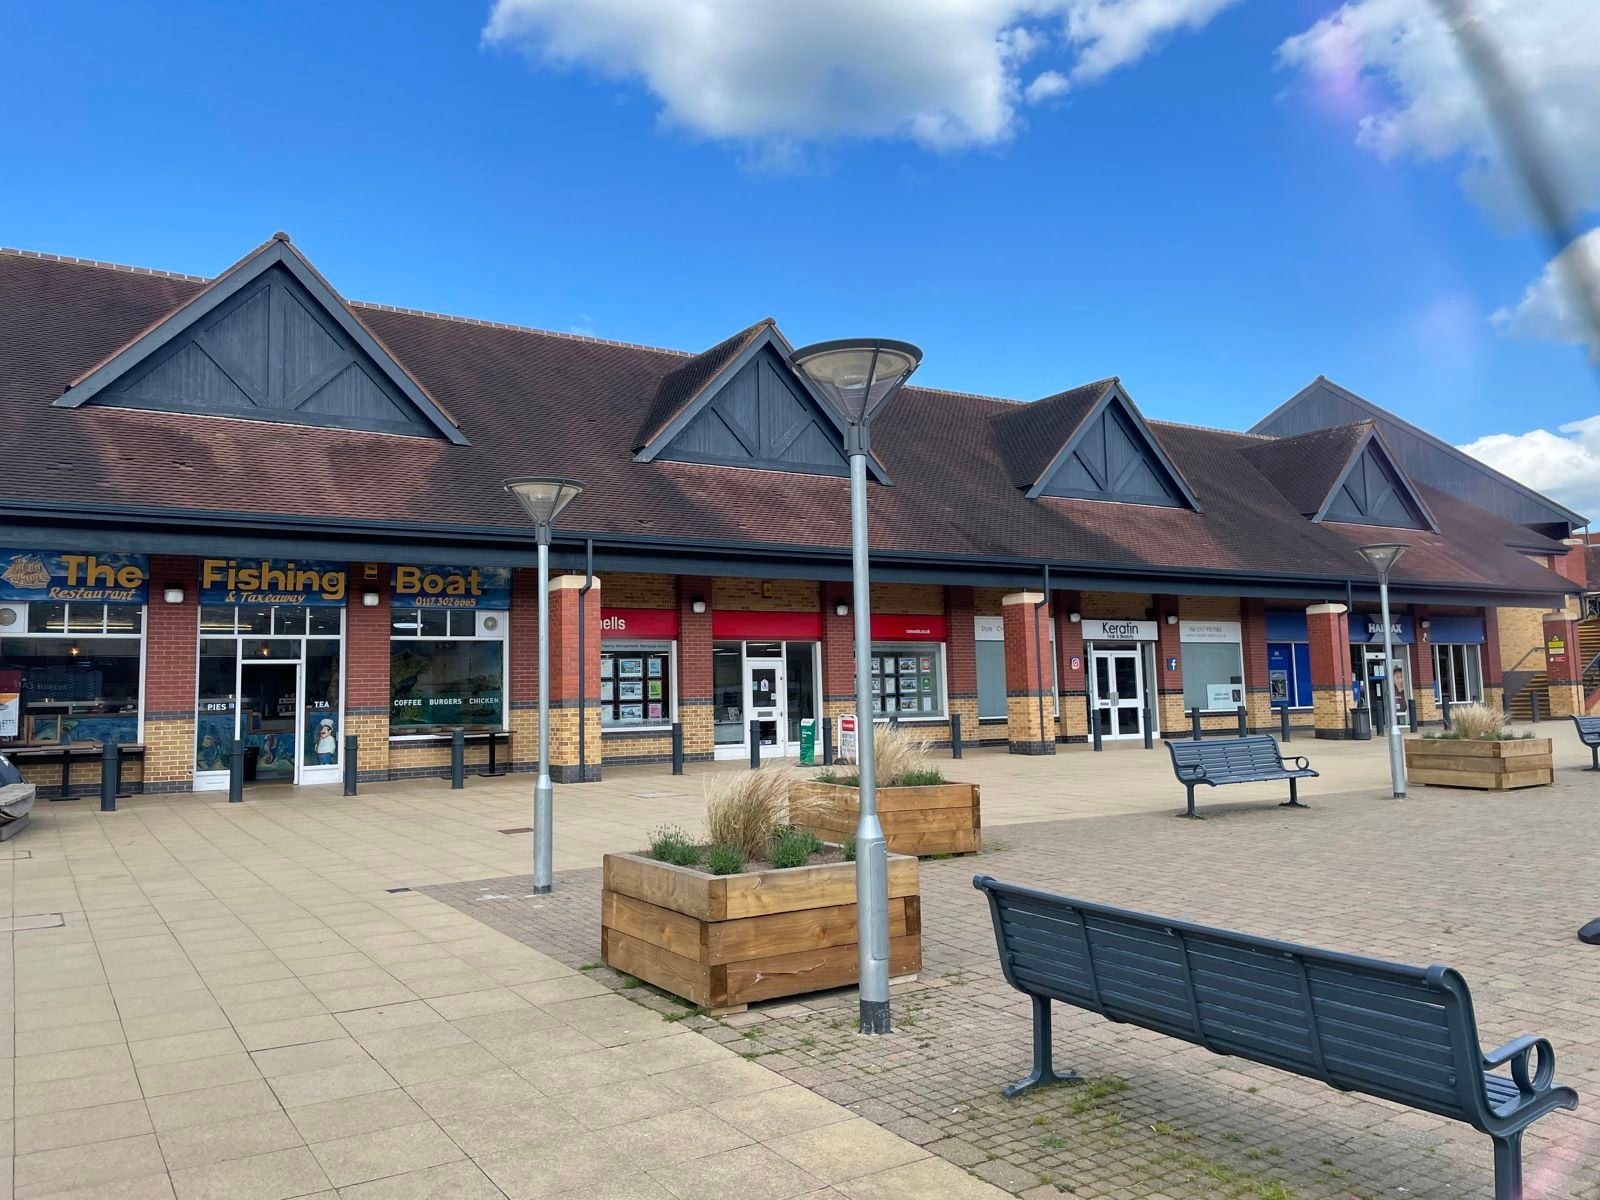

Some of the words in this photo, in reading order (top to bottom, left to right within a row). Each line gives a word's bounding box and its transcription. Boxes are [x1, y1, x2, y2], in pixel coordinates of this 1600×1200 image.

[60, 555, 143, 588] The
[202, 559, 346, 600] Fishing
[396, 566, 482, 596] Boat
[49, 587, 137, 601] Restaurant
[225, 591, 236, 603] &
[1102, 622, 1139, 635] Keratin
[207, 703, 227, 711] PIES
[469, 697, 499, 705] CHICKEN
